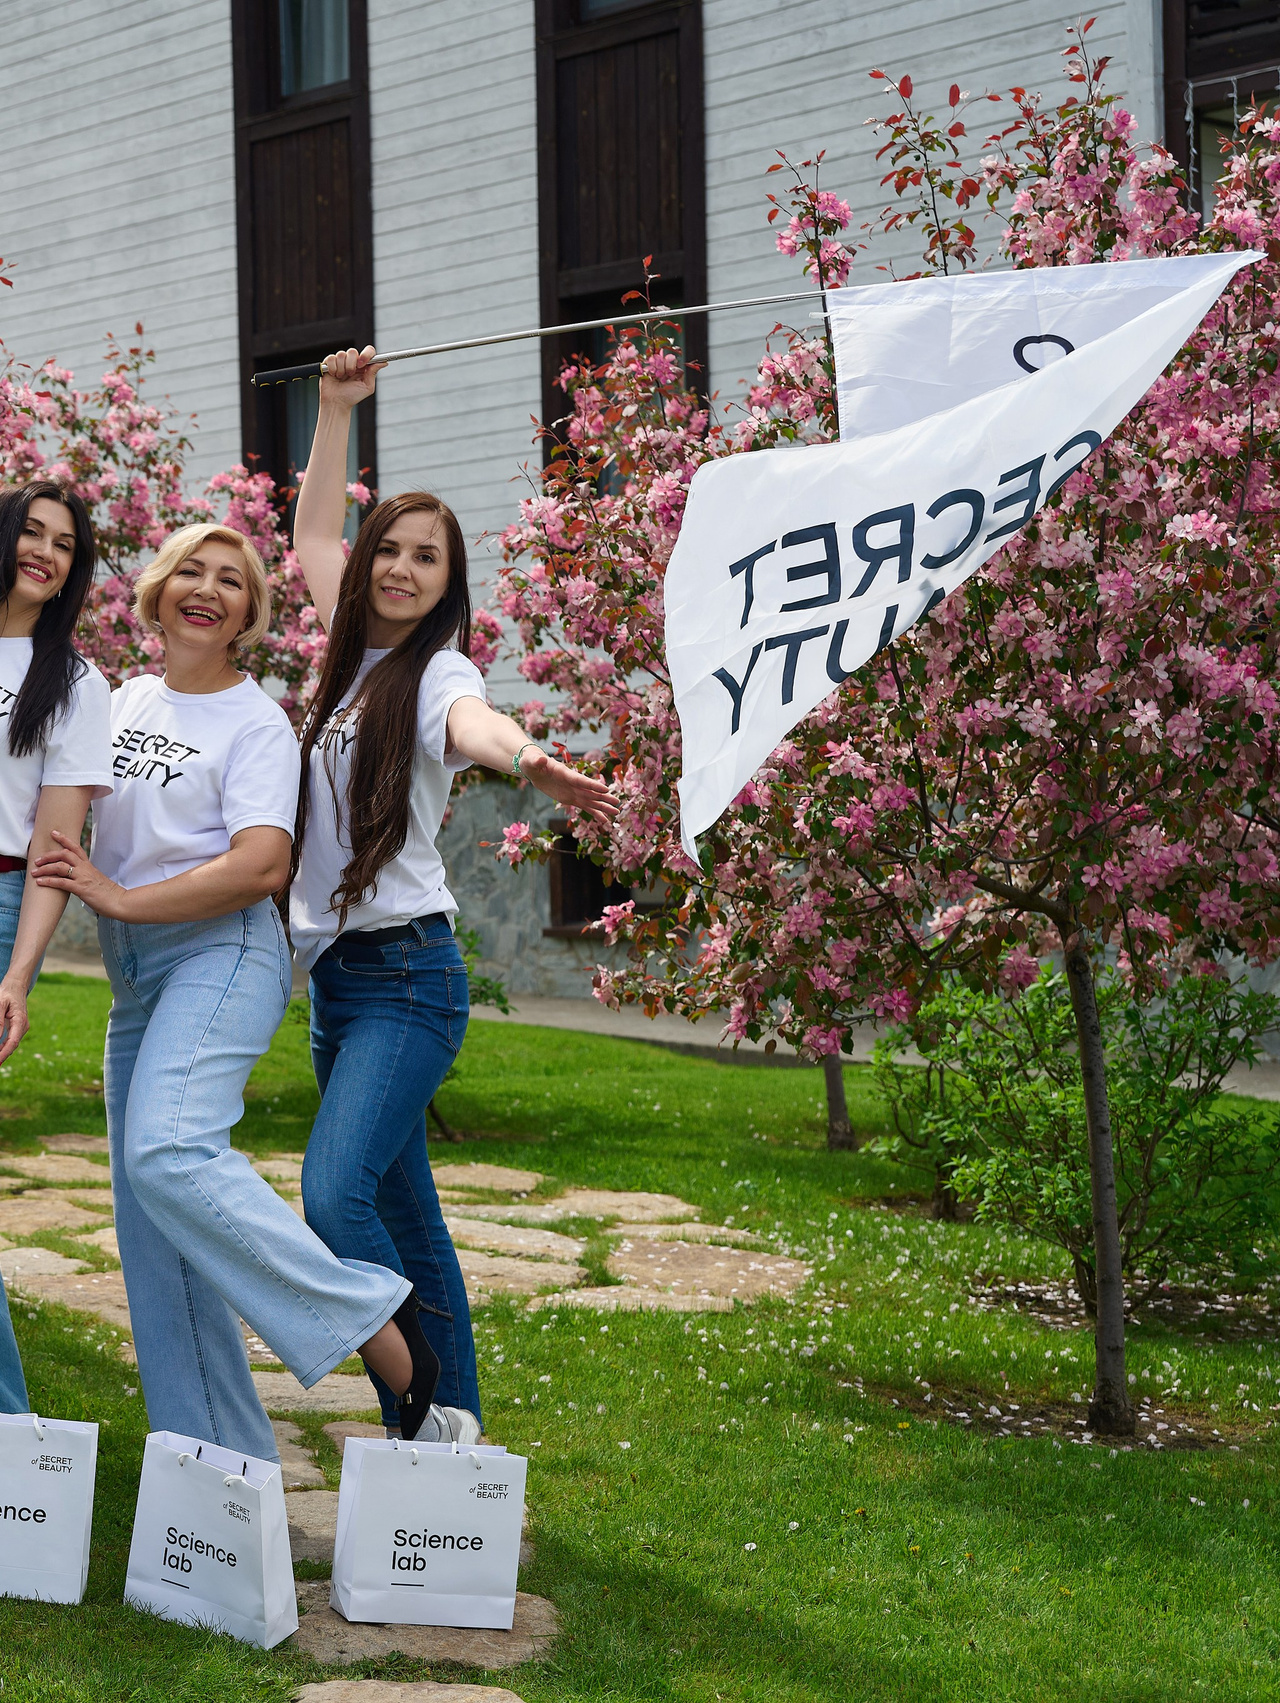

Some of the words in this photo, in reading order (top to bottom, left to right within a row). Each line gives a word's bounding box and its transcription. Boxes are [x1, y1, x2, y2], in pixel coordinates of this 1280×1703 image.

[112, 728, 201, 762] SECRET
[38, 1463, 72, 1474] BEAUTY
[40, 1455, 72, 1466] SECRET
[476, 1491, 509, 1500] BEAUTY
[477, 1483, 509, 1492] SECRET
[228, 1501, 250, 1516] SECRET
[228, 1509, 251, 1525] BEAUTY
[166, 1526, 237, 1567] Science
[393, 1528, 483, 1551] Science
[163, 1547, 193, 1574] lab
[391, 1551, 427, 1572] lab
